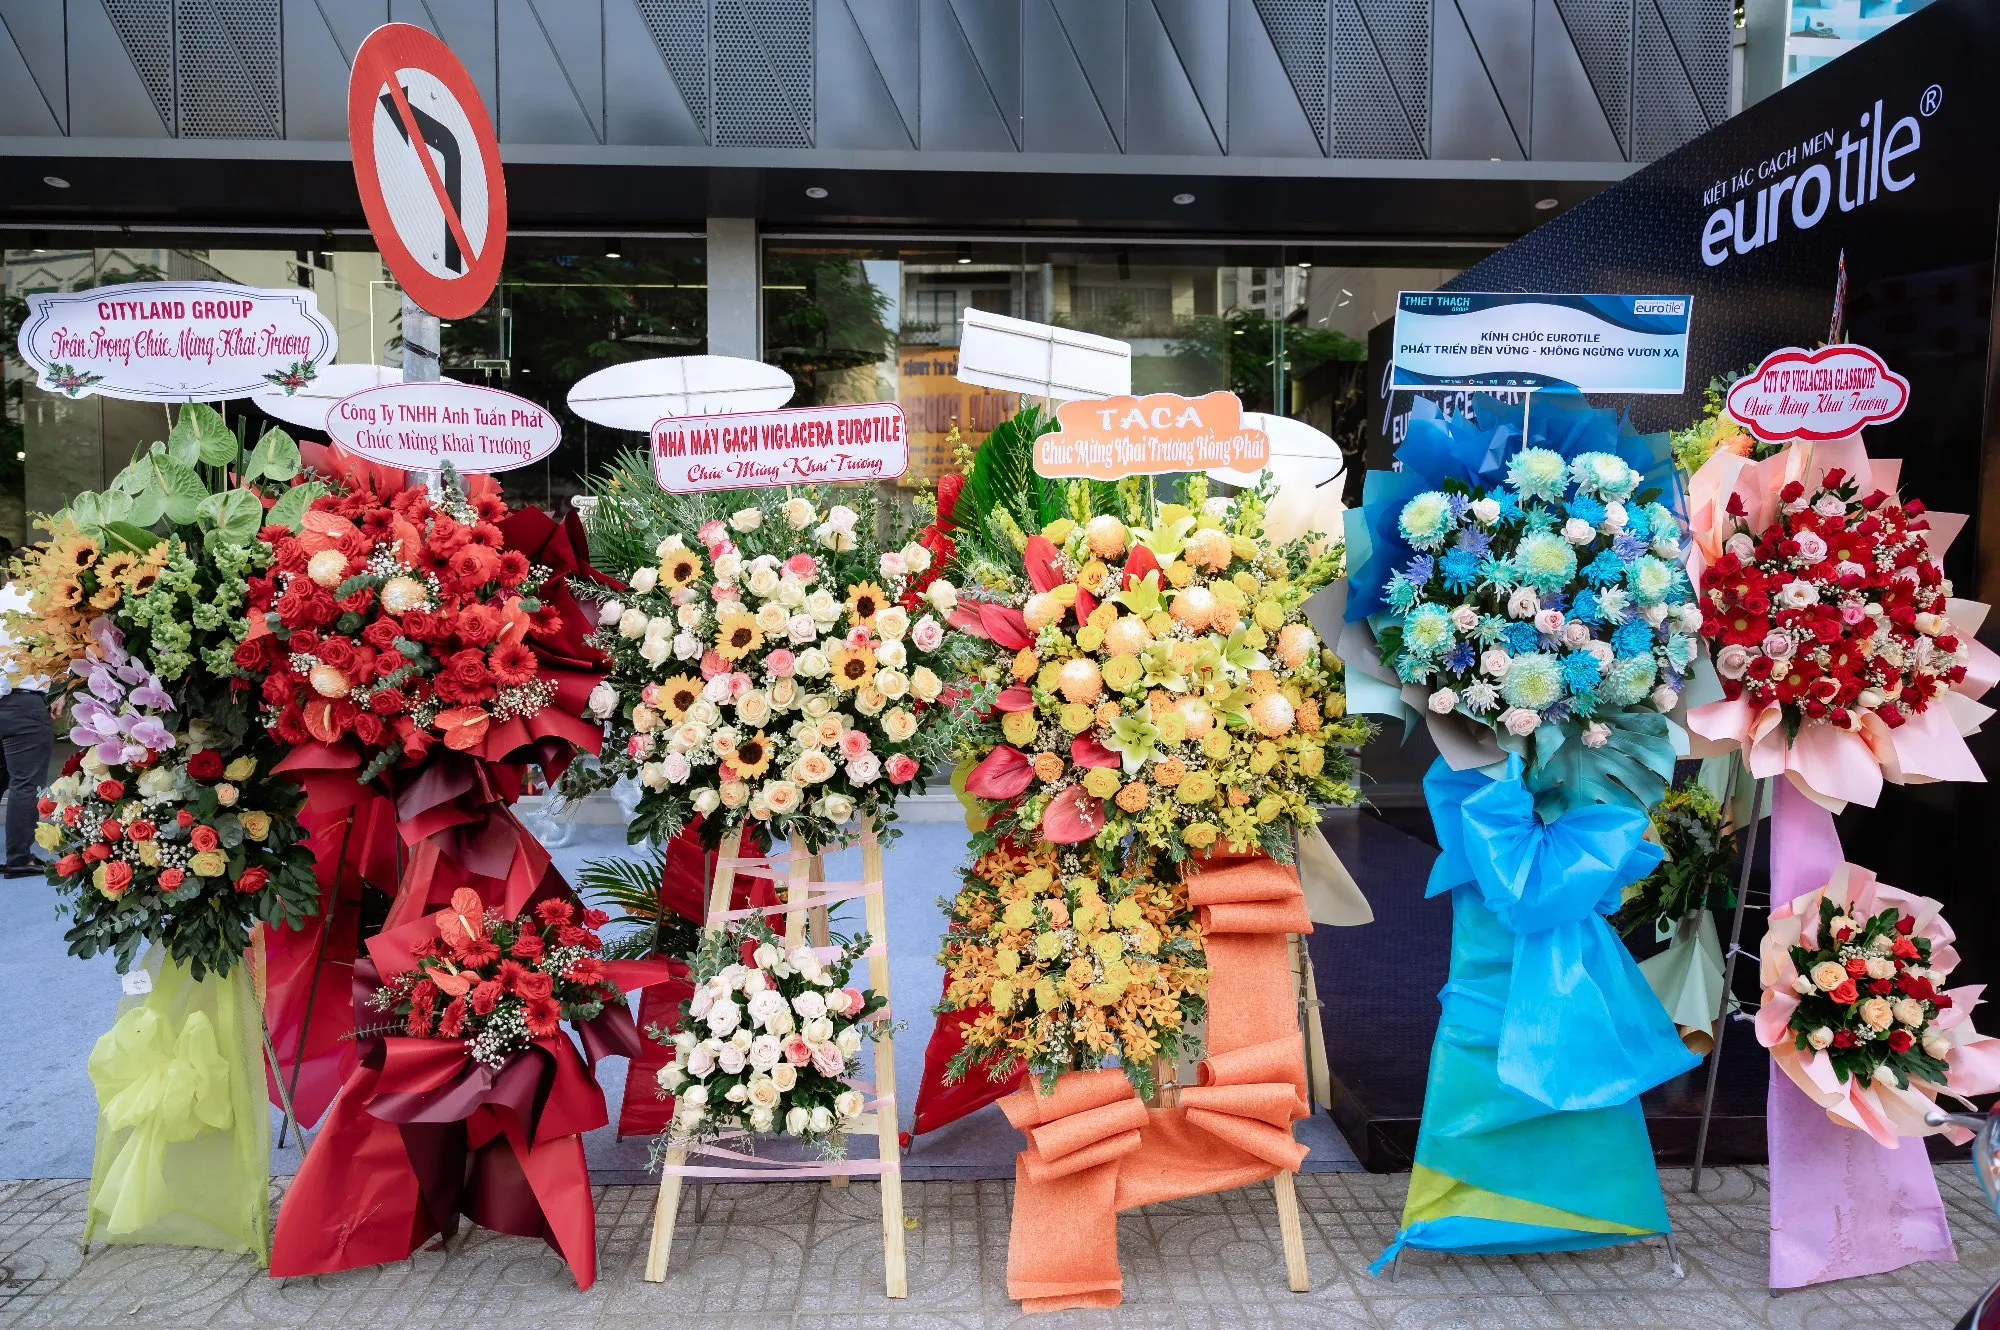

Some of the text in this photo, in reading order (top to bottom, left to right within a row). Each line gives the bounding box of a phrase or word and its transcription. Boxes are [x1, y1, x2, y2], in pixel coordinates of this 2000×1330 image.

[1703, 127, 1834, 207] KIỆT TÁC GẠCH MEN
[97, 300, 253, 321] CITYLAND GROUP
[87, 325, 132, 367] Trọng
[134, 328, 170, 359] Chúc
[168, 326, 216, 366] Mừng
[215, 327, 257, 358] Khai
[257, 323, 312, 364] Trương
[1481, 330, 1601, 343] KÍNH CHÚC EUROTILE
[1400, 342, 1431, 354] PHÁT
[1434, 342, 1467, 355] TRIỂN
[1470, 343, 1493, 355] BỀN
[1495, 344, 1529, 356] VỮNG
[1540, 345, 1580, 356] KHÔNG
[1582, 346, 1624, 357] NGỪNG
[1627, 348, 1661, 357] VƯƠN
[1663, 348, 1680, 358] XA
[1763, 371, 1780, 393] CTY
[1780, 371, 1791, 393] CP
[1792, 369, 1833, 392] VIGLACERA
[341, 403, 544, 428] Công Ty TNHH Anh Tuấn Phát
[1096, 406, 1204, 431] TACA
[1744, 396, 1773, 417] Chúc
[1774, 394, 1810, 419] Mừng
[1812, 393, 1846, 413] Khai
[356, 428, 532, 460] Chúc Mừng Khai Trương
[658, 415, 901, 459] NHÀ MÁY GẠCH VIGLACERA EUROTILE
[1041, 427, 1265, 469] Chúc Mừng Khai Trương Hồng Phát
[687, 453, 883, 483] Chúc Mừng Khai Trương
